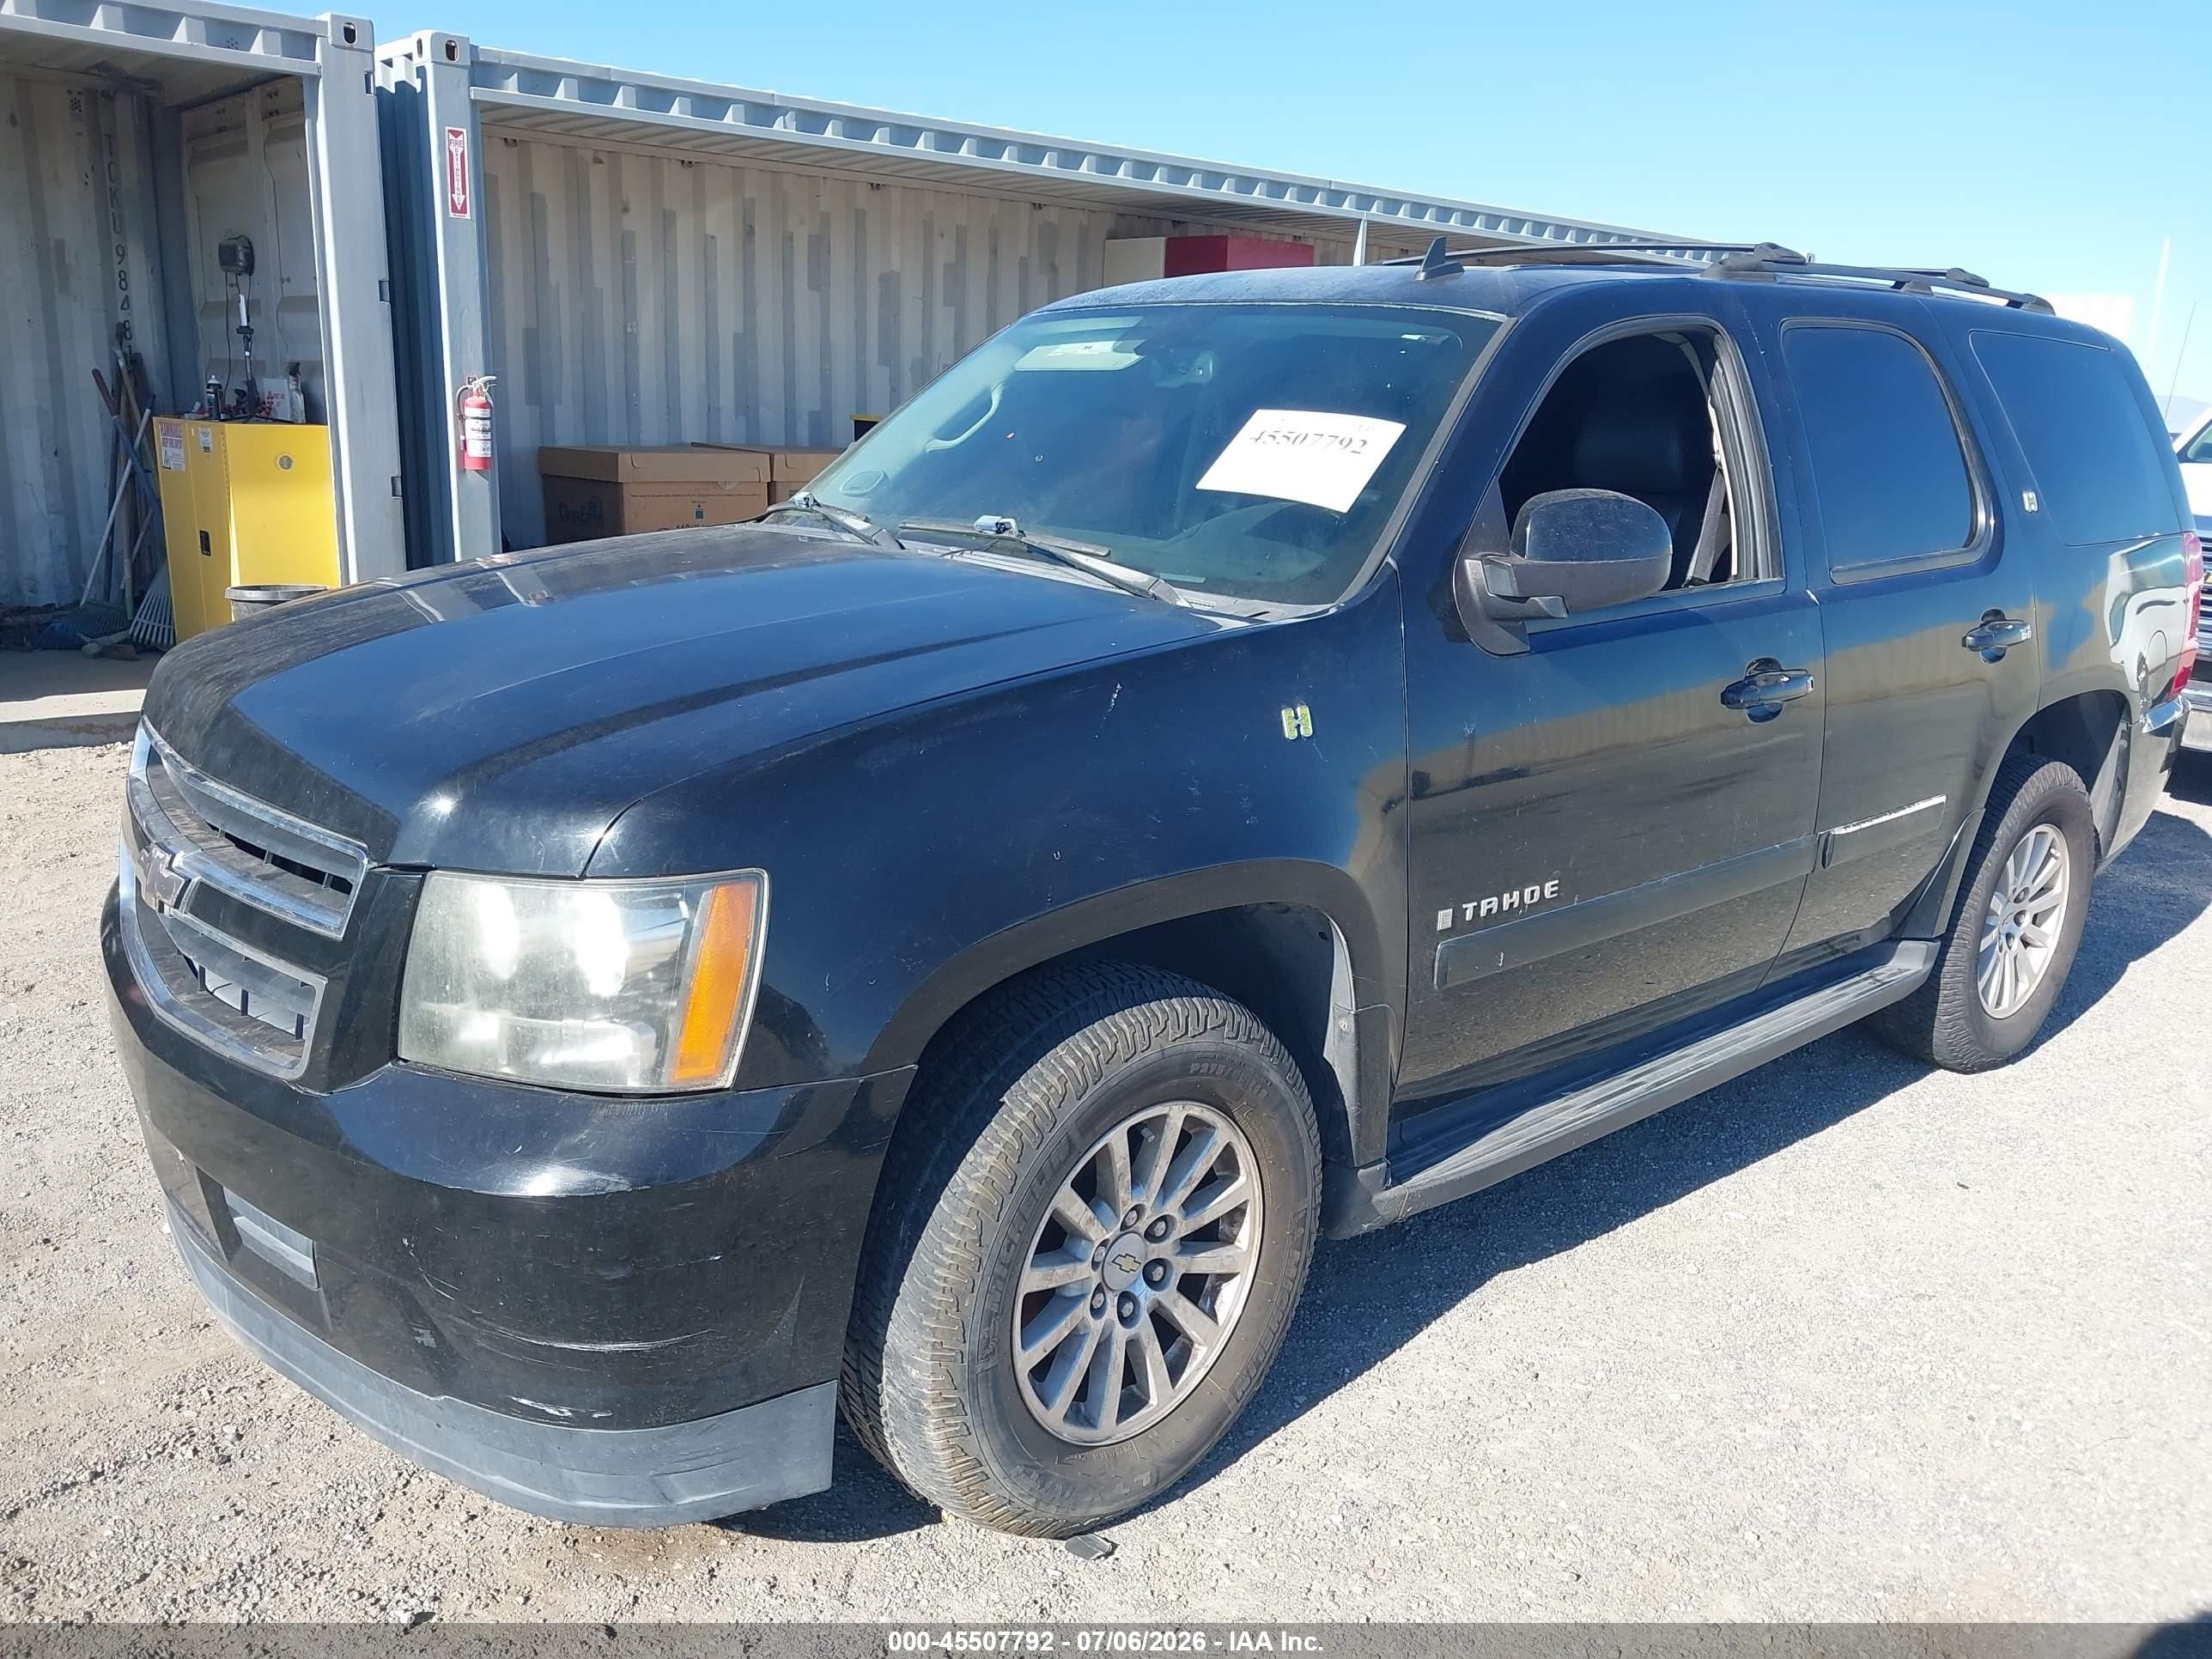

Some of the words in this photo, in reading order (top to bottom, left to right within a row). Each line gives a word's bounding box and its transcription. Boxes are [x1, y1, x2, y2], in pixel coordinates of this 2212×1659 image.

[449, 139, 464, 149] FIRE
[1249, 429, 1369, 453] 45507792
[1462, 879, 1559, 921] TAHOE
[988, 1133, 1075, 1316] MICHELIN
